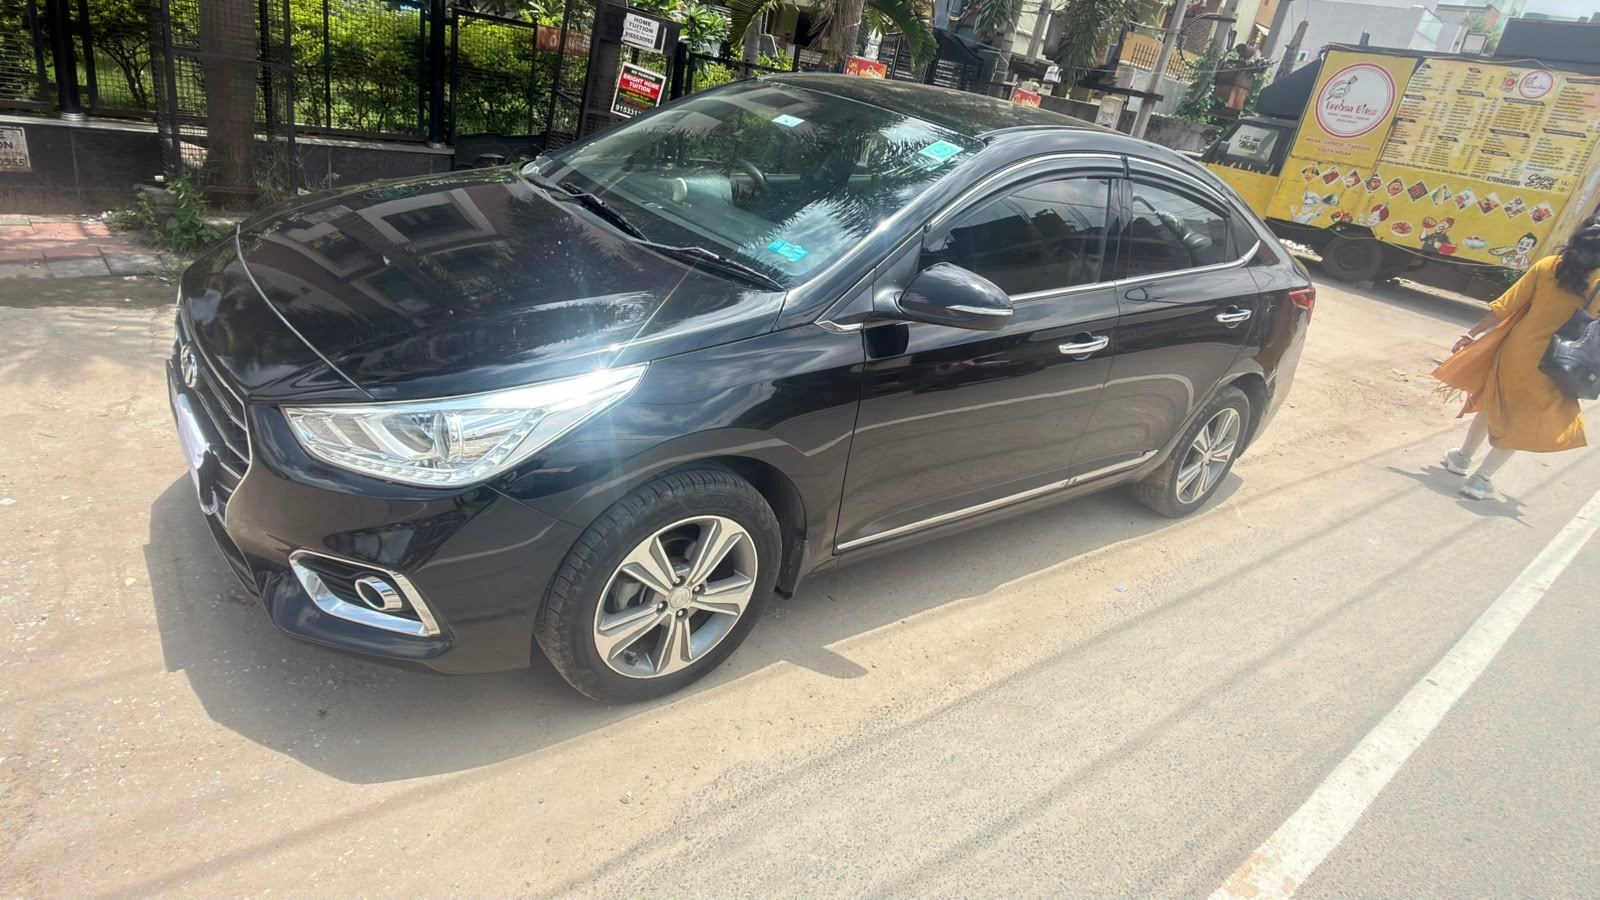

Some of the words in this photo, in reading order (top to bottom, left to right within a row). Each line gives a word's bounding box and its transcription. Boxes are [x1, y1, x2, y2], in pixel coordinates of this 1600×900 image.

[629, 22, 653, 33] TUITION
[633, 17, 652, 27] HOME
[623, 73, 643, 84] BRIGHT
[643, 80, 660, 90] HOME
[629, 82, 651, 93] TUITION
[1527, 173, 1559, 185] Coffee
